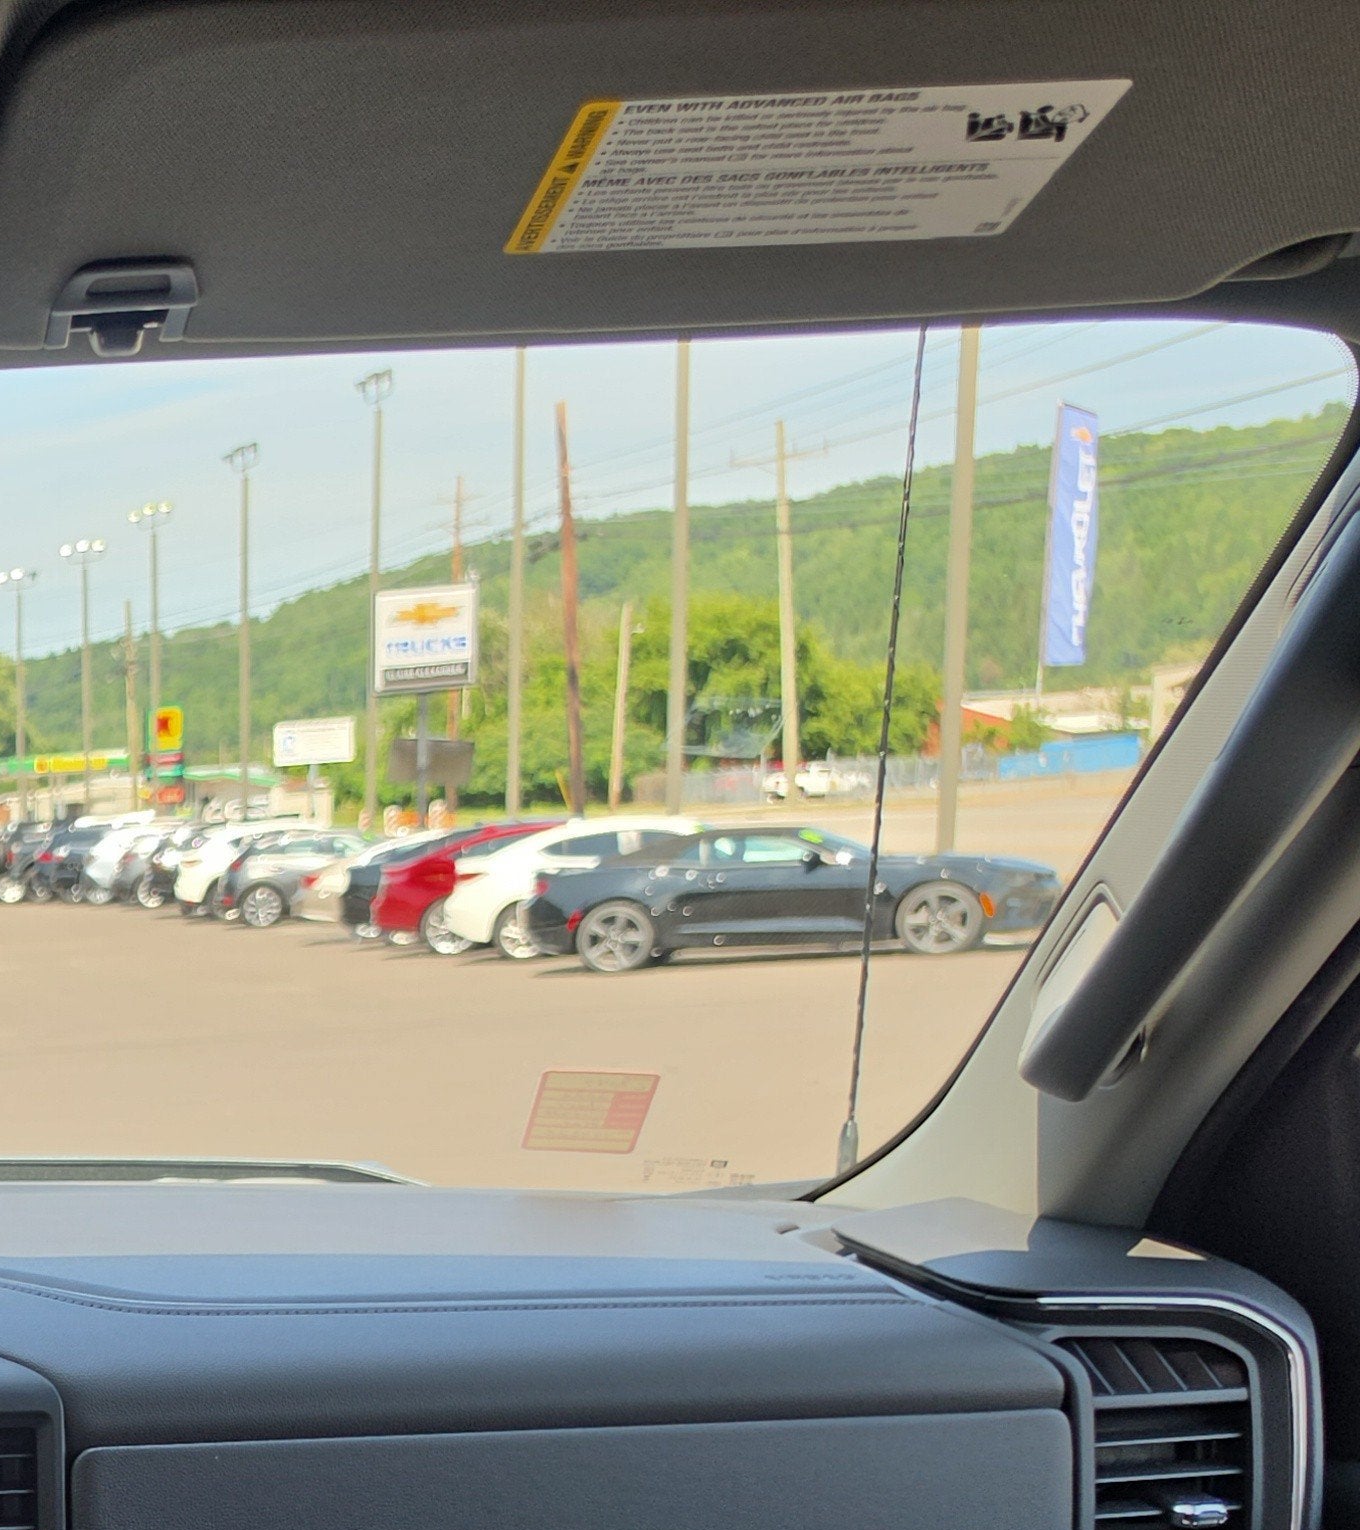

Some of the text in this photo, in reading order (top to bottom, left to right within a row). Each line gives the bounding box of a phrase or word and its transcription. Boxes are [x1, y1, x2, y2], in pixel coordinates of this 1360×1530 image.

[623, 91, 922, 115] EVEN WITH ADVANCED AIR BAGS
